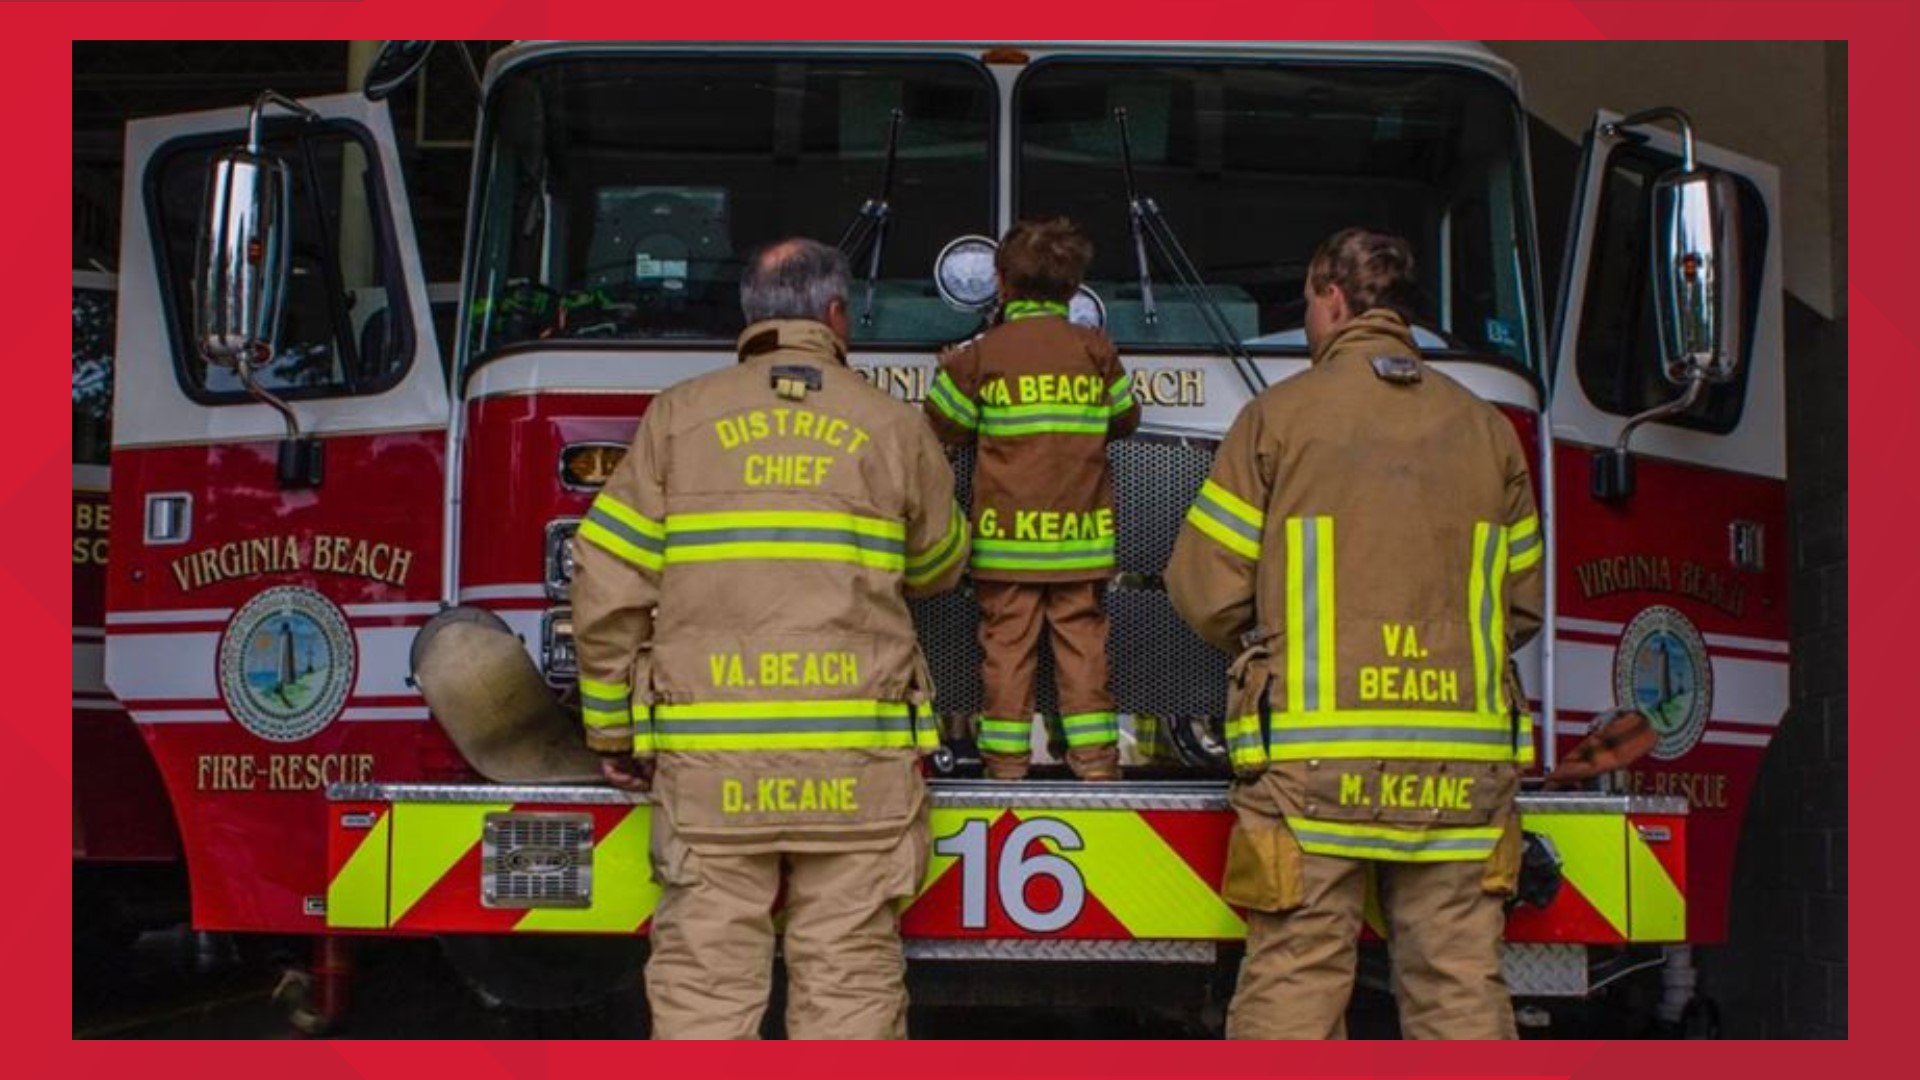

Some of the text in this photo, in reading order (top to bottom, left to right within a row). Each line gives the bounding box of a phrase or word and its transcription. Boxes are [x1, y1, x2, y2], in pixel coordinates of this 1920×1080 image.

[979, 375, 1103, 405] VA BEACH
[1131, 369, 1206, 406] ACH
[715, 408, 870, 454] DISTRICT
[744, 455, 834, 487] CHIEF
[75, 504, 111, 530] BE
[979, 508, 1113, 540] G. KEANE
[72, 538, 109, 564] SC
[171, 536, 413, 591] VIRGINIA BEACH
[1576, 554, 1673, 600] VIRGINIA
[1382, 624, 1429, 658] VA.
[1358, 666, 1459, 702] BEACH
[196, 754, 375, 791] FIRE-RESCUE
[722, 778, 858, 816] D. KEANE
[1339, 772, 1475, 811] M. KEANE
[934, 816, 1087, 934] 16
